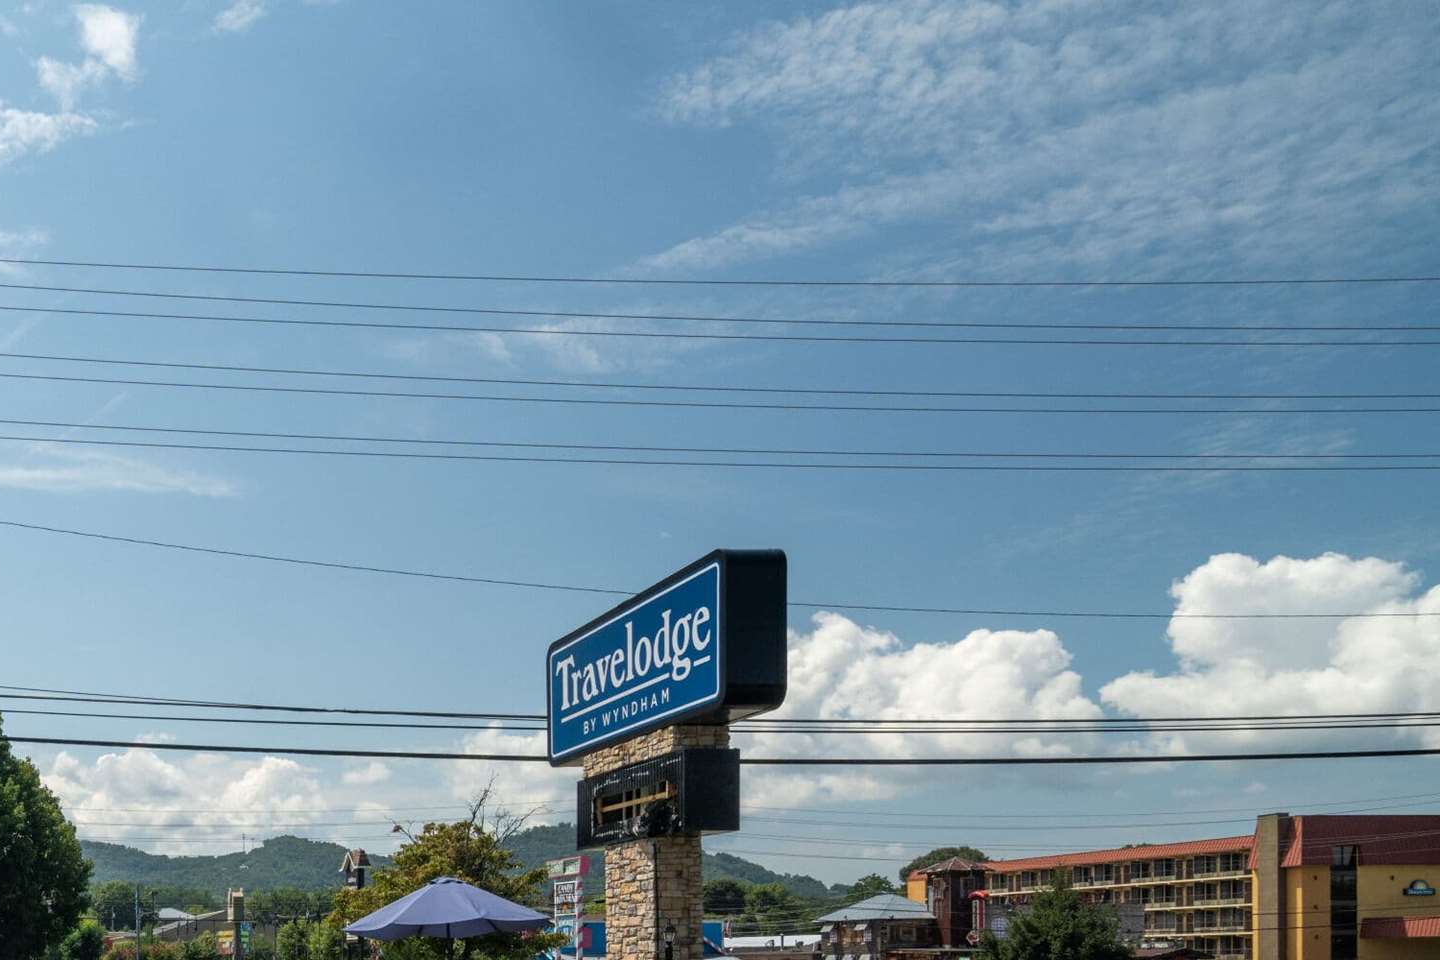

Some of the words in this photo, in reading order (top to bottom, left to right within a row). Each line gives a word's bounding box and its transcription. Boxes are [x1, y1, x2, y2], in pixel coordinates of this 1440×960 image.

[556, 606, 711, 711] Travelodge
[583, 719, 597, 736] BY
[602, 688, 670, 726] WYNDHAM
